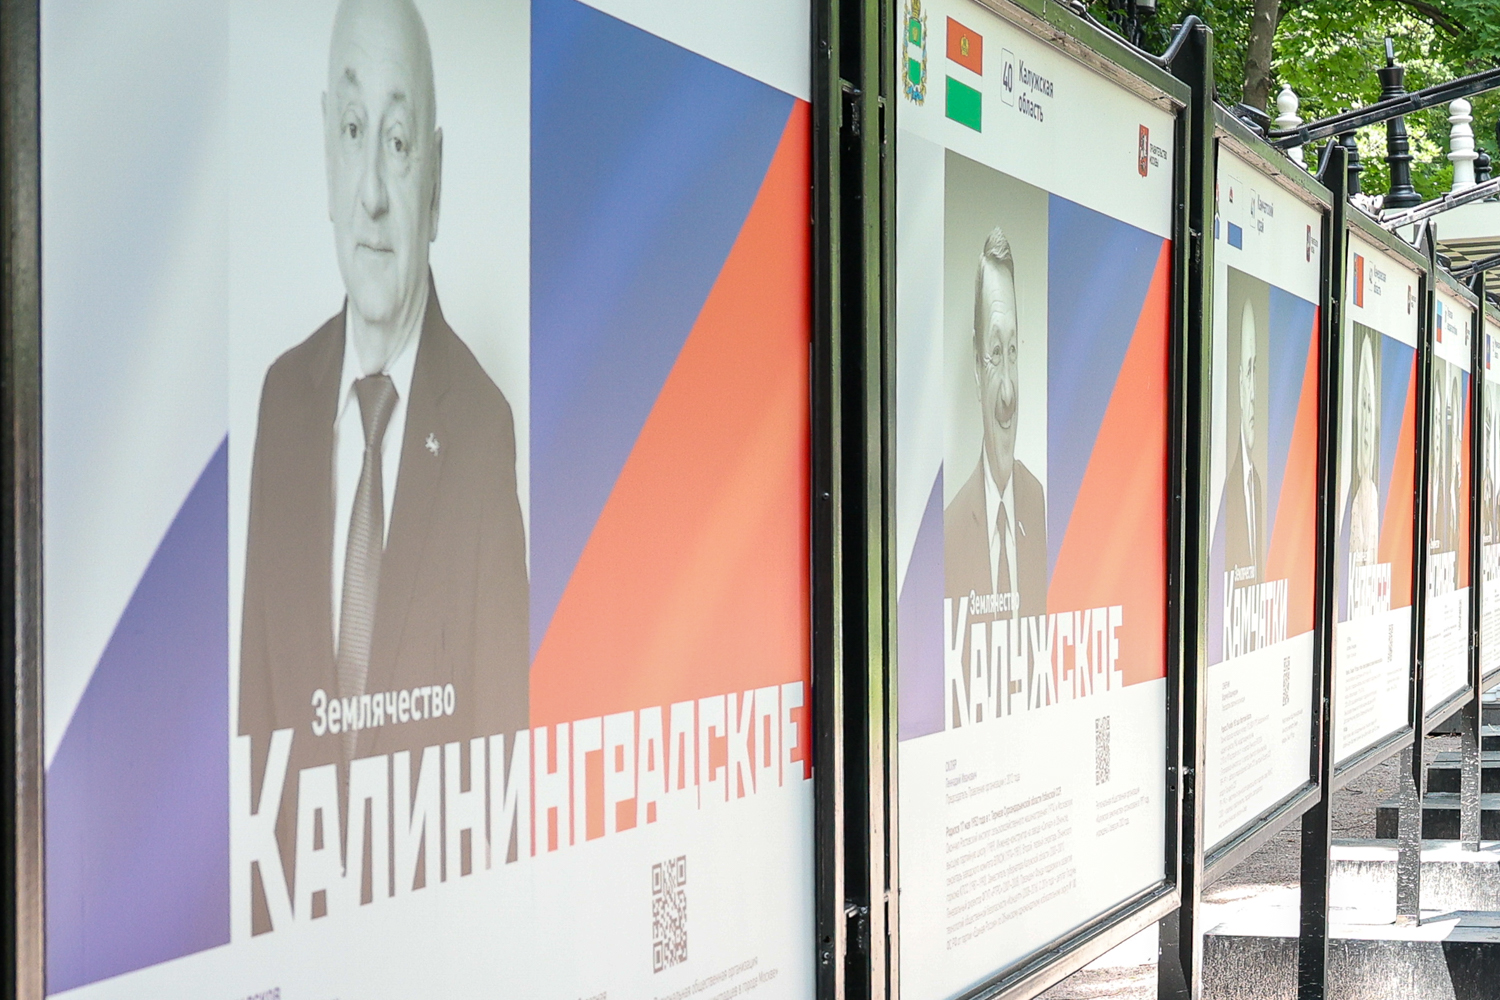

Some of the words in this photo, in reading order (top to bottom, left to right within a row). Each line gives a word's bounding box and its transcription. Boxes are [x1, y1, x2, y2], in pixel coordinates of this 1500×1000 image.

[1003, 61, 1013, 93] 40
[1019, 59, 1054, 98] Калужская
[1018, 92, 1044, 122] область
[969, 589, 1020, 615] Землячество
[944, 596, 1123, 730] КАЛУЖСКОЕ
[311, 683, 455, 736] Землячество
[231, 681, 812, 942] КАЛИНИНГРАДСКОЕ
